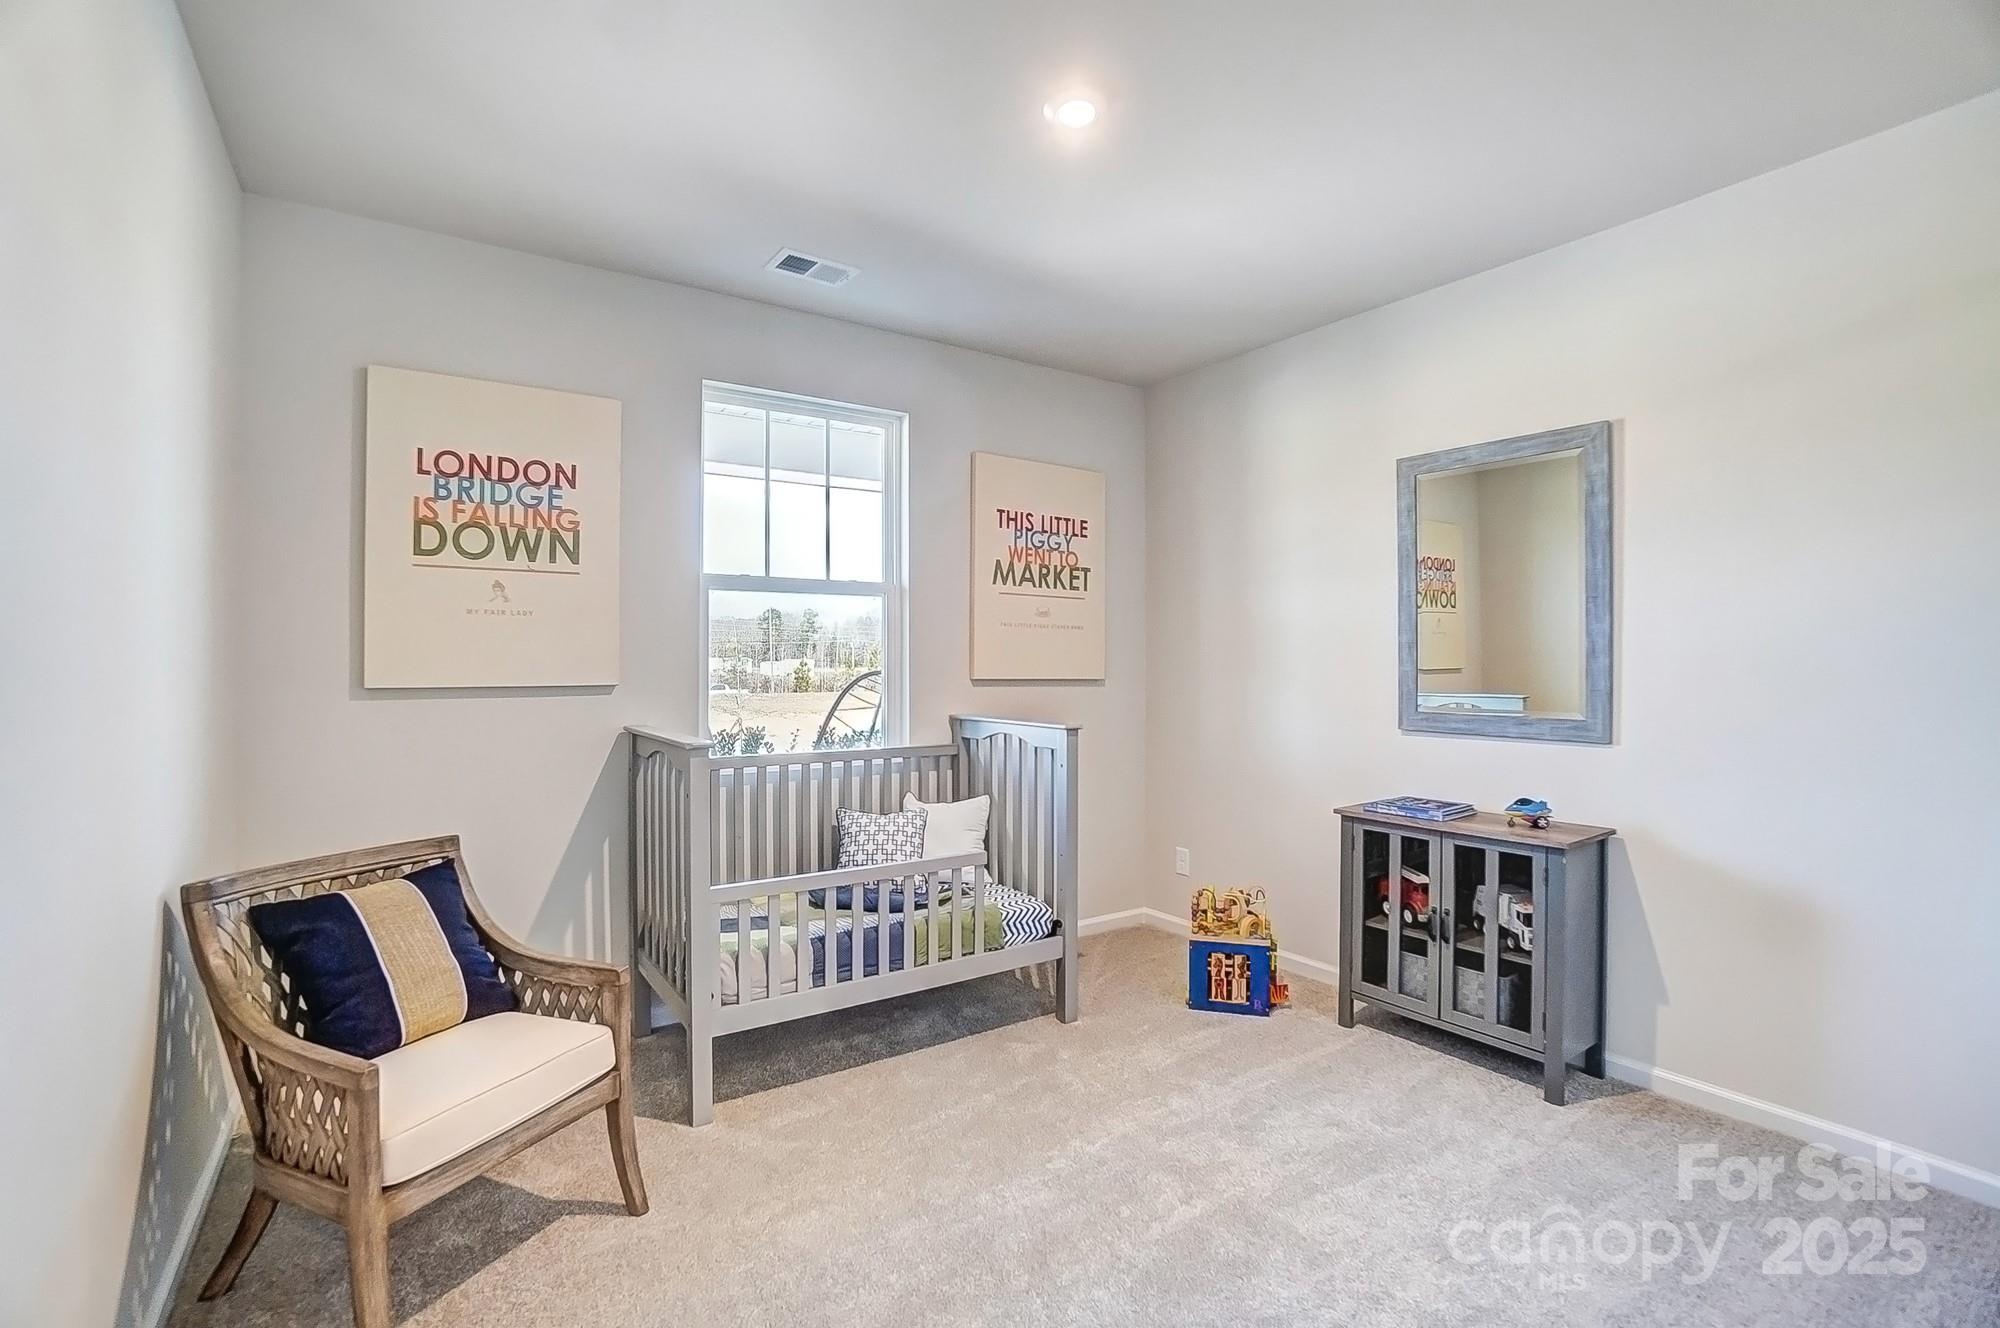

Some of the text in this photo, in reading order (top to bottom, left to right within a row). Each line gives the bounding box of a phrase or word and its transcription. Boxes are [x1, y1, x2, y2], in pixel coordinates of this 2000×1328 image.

[417, 447, 577, 490] LONDON
[434, 474, 564, 511] BRIDGE
[413, 496, 581, 532] IS FALLING
[996, 508, 1088, 538] THIS LITTLE
[413, 519, 581, 565] DOWN
[1008, 545, 1079, 568] WENT TO
[1014, 529, 1073, 552] PIGGY
[992, 559, 1091, 592] MARKET
